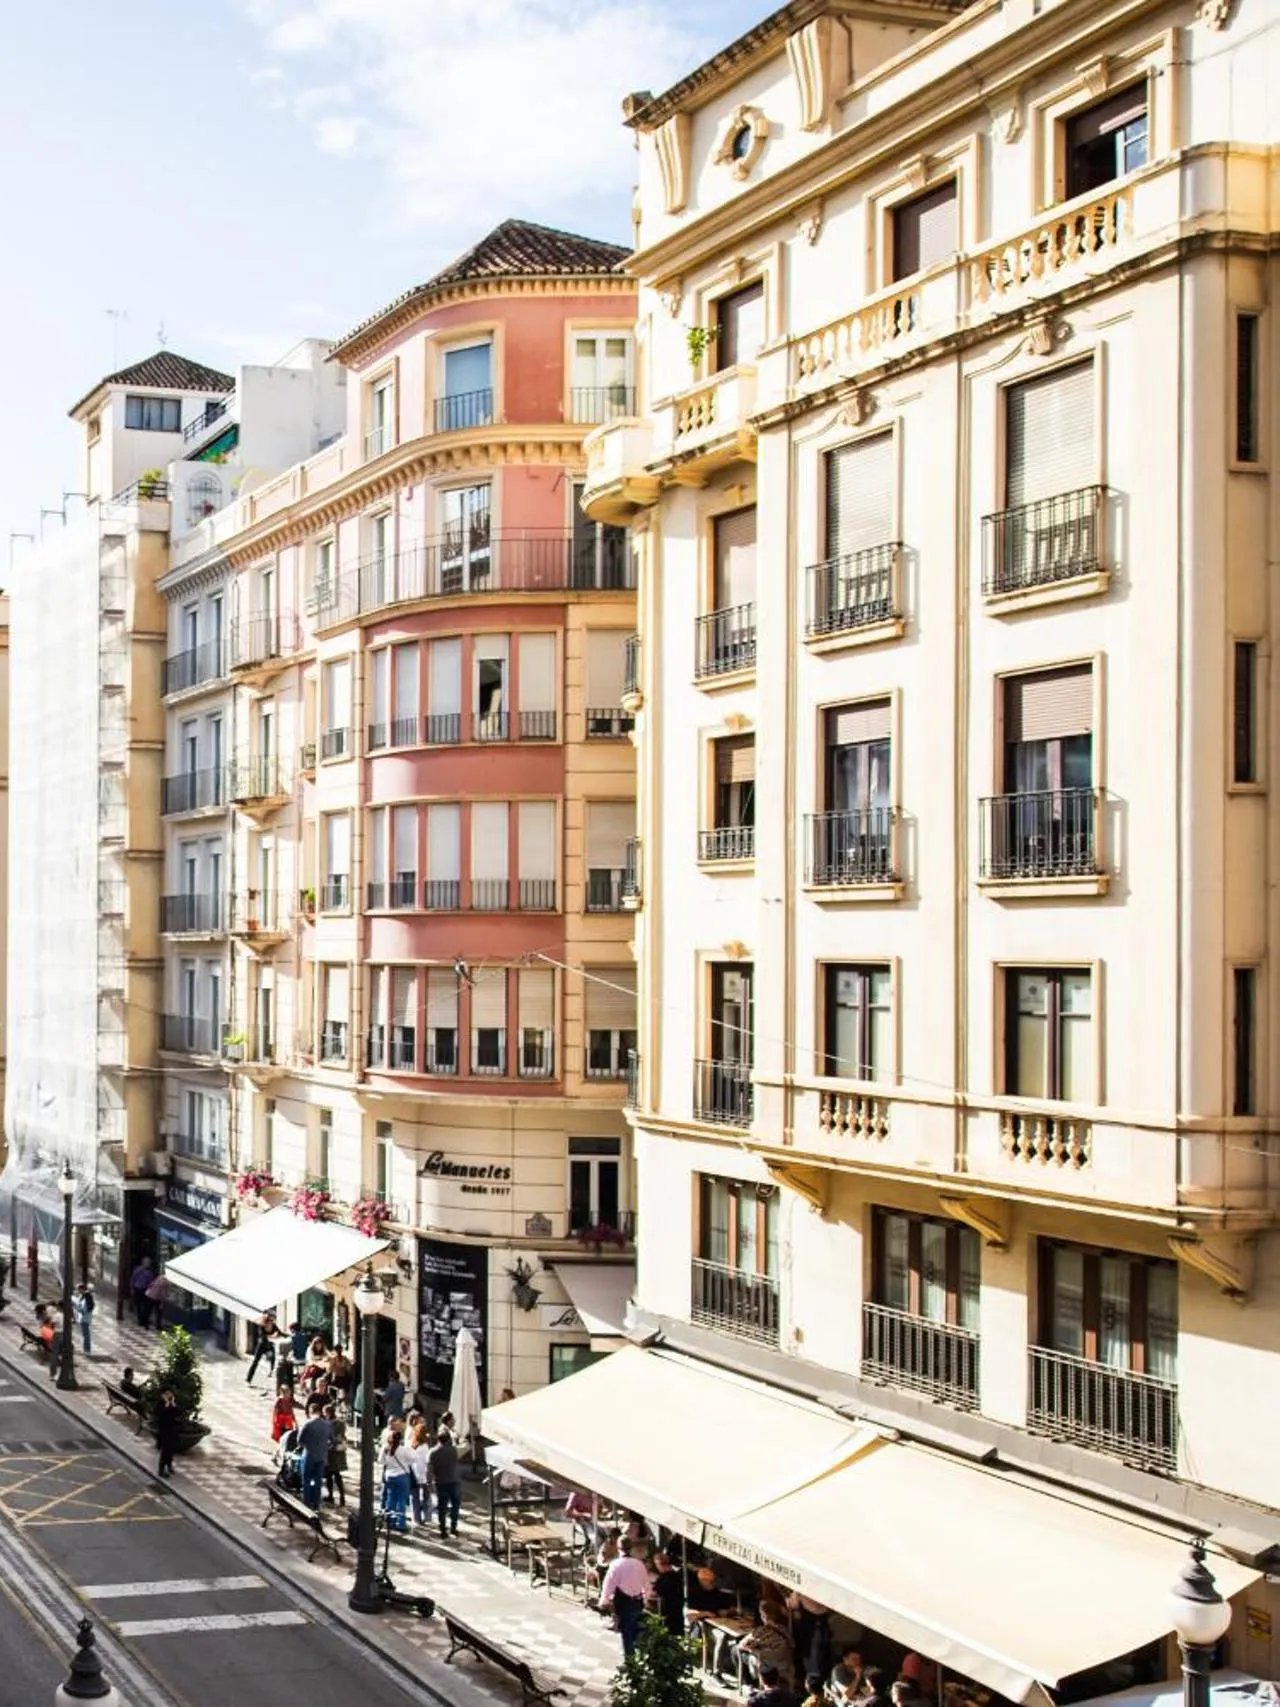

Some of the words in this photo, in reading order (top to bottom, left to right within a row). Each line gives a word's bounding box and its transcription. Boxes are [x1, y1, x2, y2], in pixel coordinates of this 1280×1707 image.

[440, 1161, 511, 1180] Manueles
[712, 1533, 752, 1562] CERVEZAS
[754, 1553, 802, 1585] ALHAMBRA
